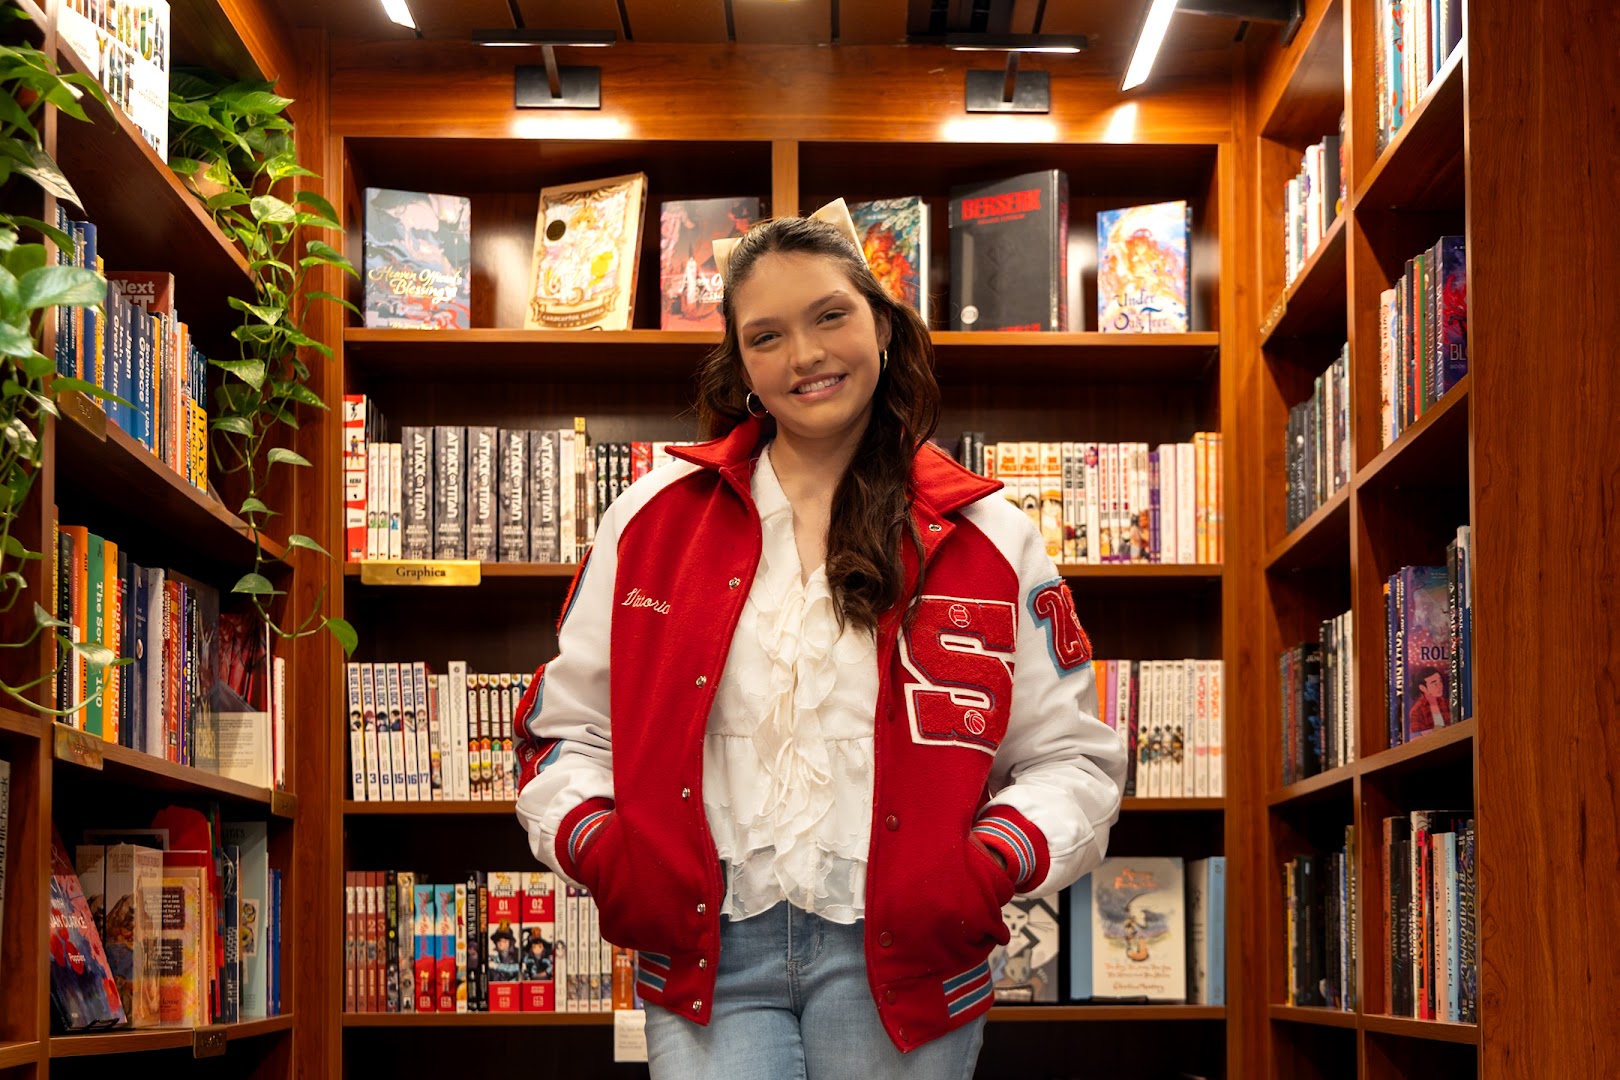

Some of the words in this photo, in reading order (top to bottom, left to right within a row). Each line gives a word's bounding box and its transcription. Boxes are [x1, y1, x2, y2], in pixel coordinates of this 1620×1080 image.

[961, 189, 1041, 221] BERSERK
[368, 266, 416, 282] Heaven
[114, 280, 155, 294] Next
[1113, 287, 1154, 307] Under
[1450, 344, 1466, 361] BL
[415, 433, 425, 477] ATTACK
[447, 432, 458, 475] ATTACK
[479, 433, 490, 476] ATTACK
[511, 435, 522, 478] ATTACK
[542, 435, 552, 479] ATTACK
[415, 486, 425, 520] TITAN
[447, 485, 458, 518] TITAN
[479, 486, 490, 519] TITAN
[512, 487, 522, 521] TITAN
[542, 489, 552, 522] TITAN
[395, 567, 447, 580] Graphica
[1421, 646, 1449, 661] ROL
[350, 668, 358, 686] BLUE
[363, 668, 371, 686] BLUE
[376, 669, 384, 687] BLUE
[389, 669, 397, 686] BLUE
[415, 668, 423, 686] BLUE
[898, 595, 1016, 757] S
[351, 687, 359, 705] LOCK
[364, 687, 372, 705] LOCK
[377, 687, 385, 706] LOCK
[390, 687, 398, 705] LOCK
[404, 688, 412, 706] LOCK
[416, 687, 424, 705] LOCK
[355, 773, 362, 784] 2
[370, 773, 377, 784] 3
[382, 774, 389, 785] 6
[395, 773, 404, 784] 15
[408, 774, 417, 785] 16
[420, 773, 429, 784] 17
[498, 900, 508, 910] 01
[532, 898, 543, 909] 02
